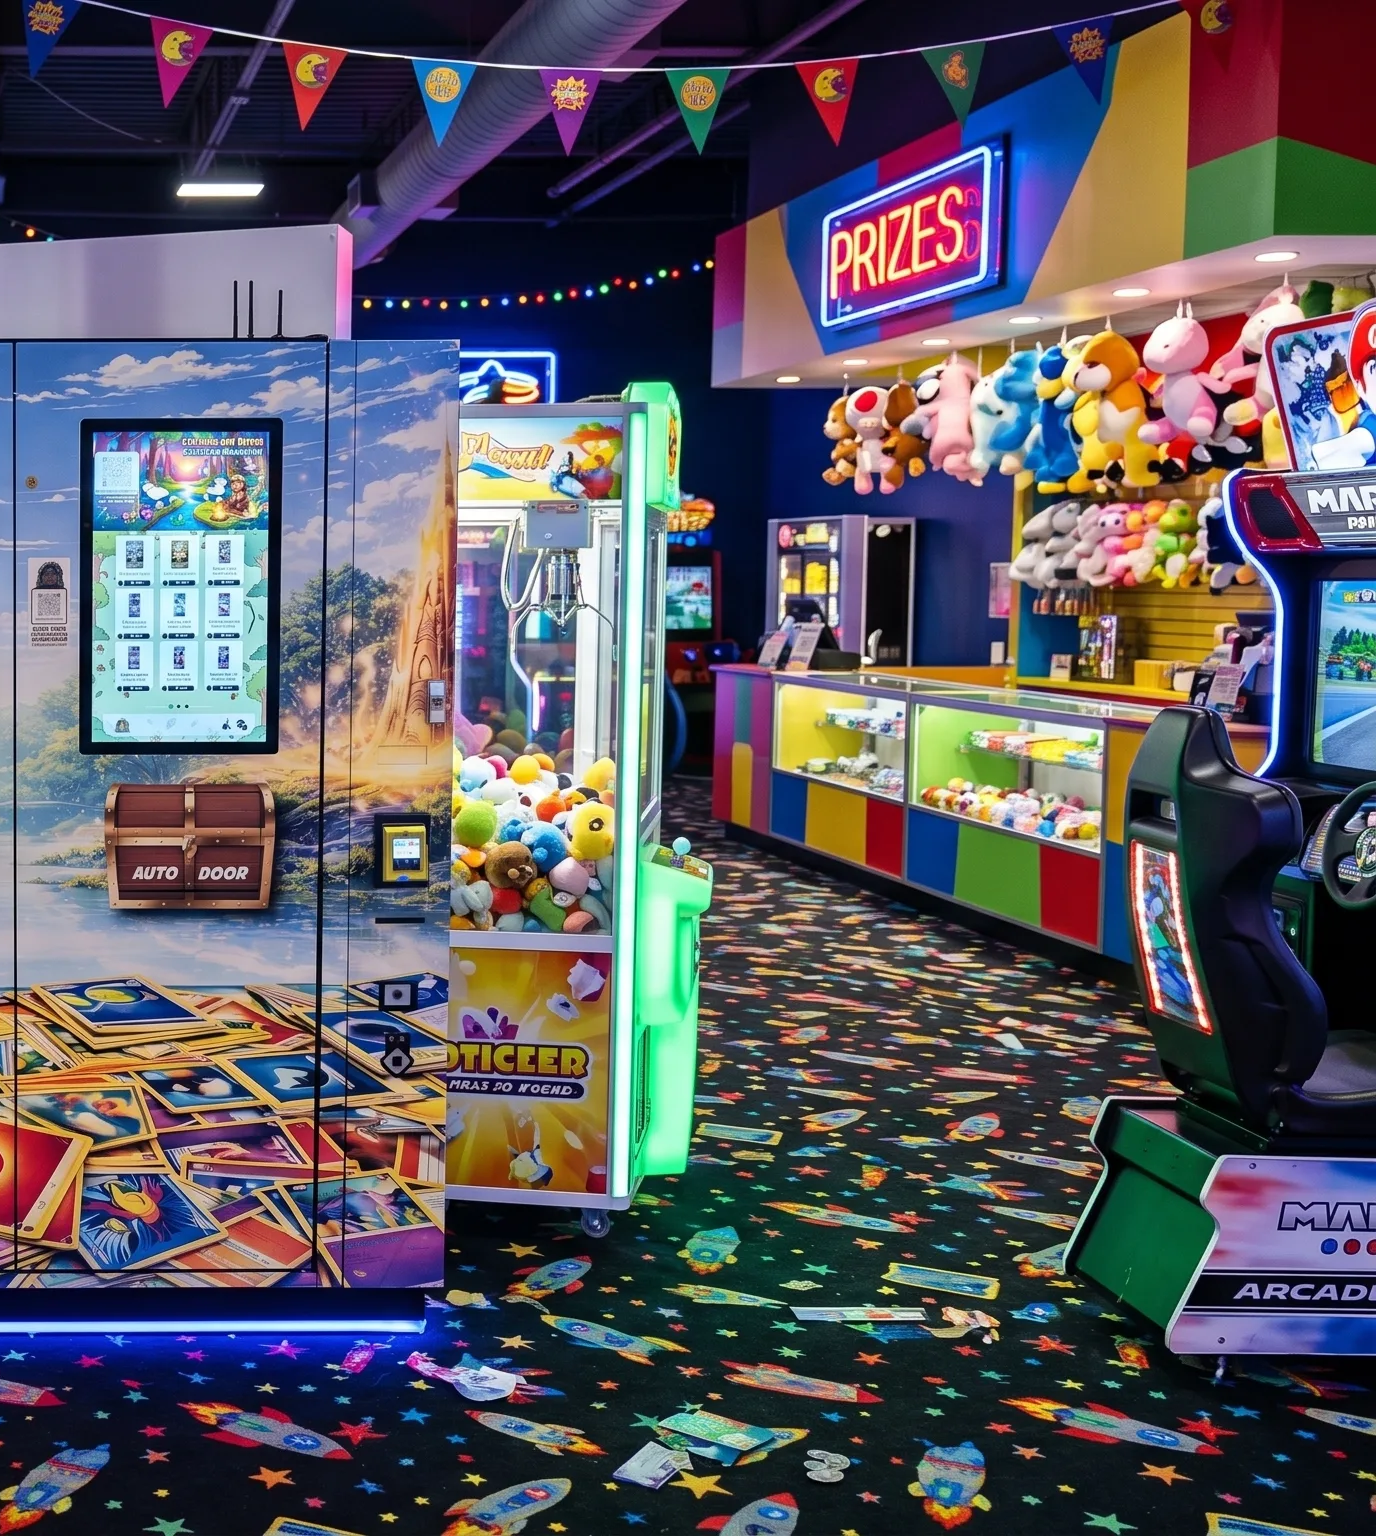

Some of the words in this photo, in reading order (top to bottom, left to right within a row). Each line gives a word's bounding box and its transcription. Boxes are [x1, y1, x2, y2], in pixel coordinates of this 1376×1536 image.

[829, 185, 966, 300] PRIZES
[132, 865, 180, 881] AUTO
[197, 865, 250, 881] DOOR
